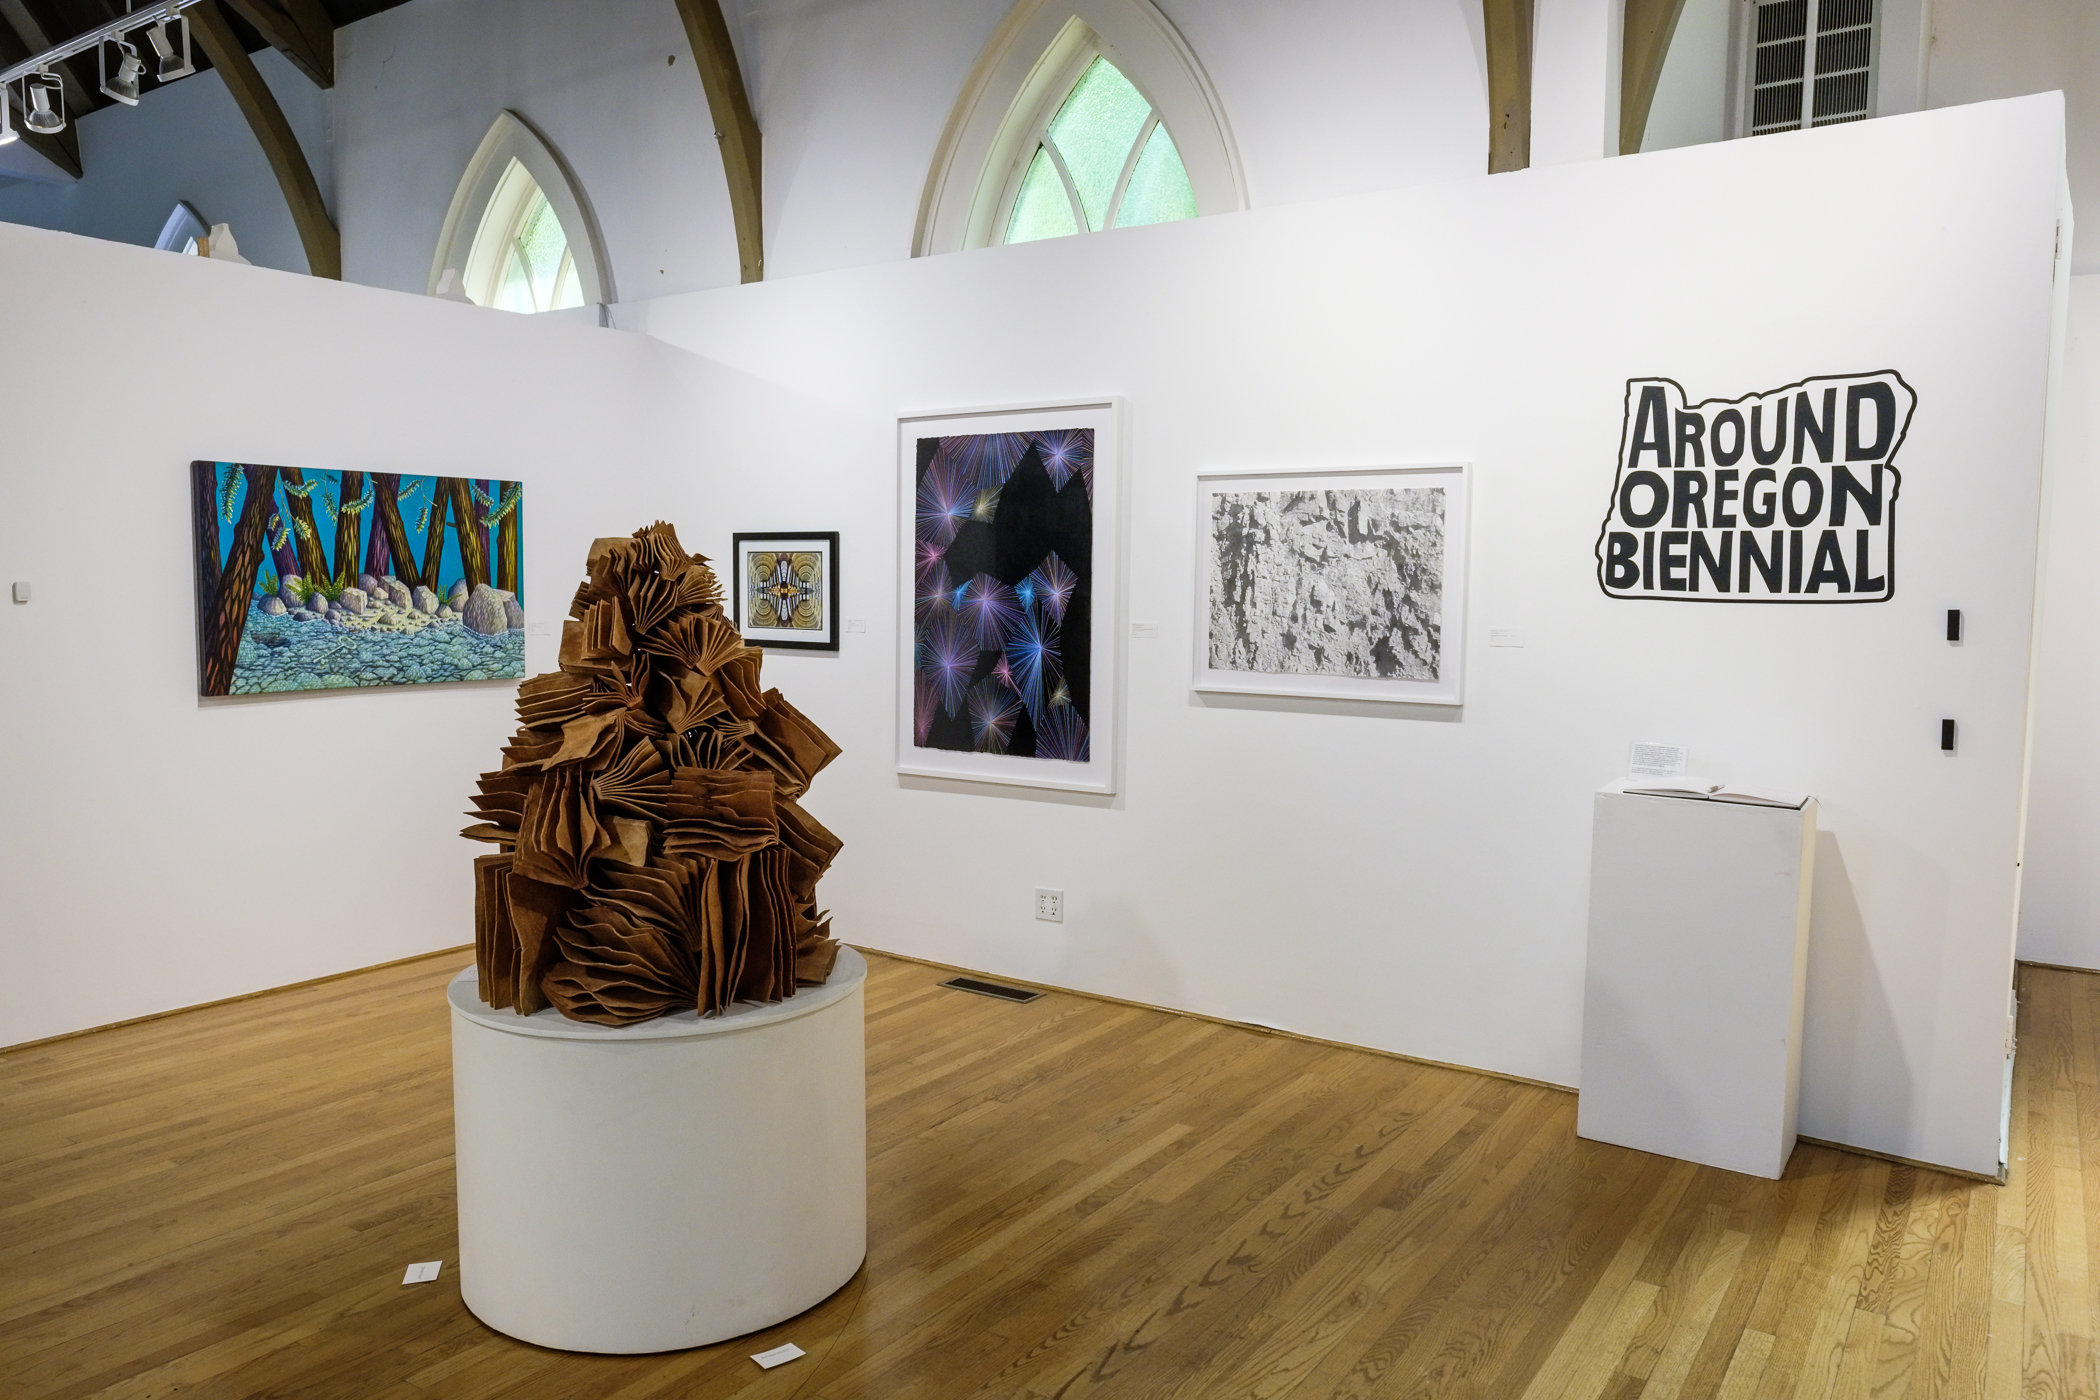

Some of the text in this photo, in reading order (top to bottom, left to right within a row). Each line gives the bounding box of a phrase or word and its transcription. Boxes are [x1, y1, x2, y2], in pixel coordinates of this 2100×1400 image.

[1627, 381, 1896, 468] AROUND
[1619, 463, 1884, 528] OREGON
[1605, 529, 1885, 593] BIENNIAL
